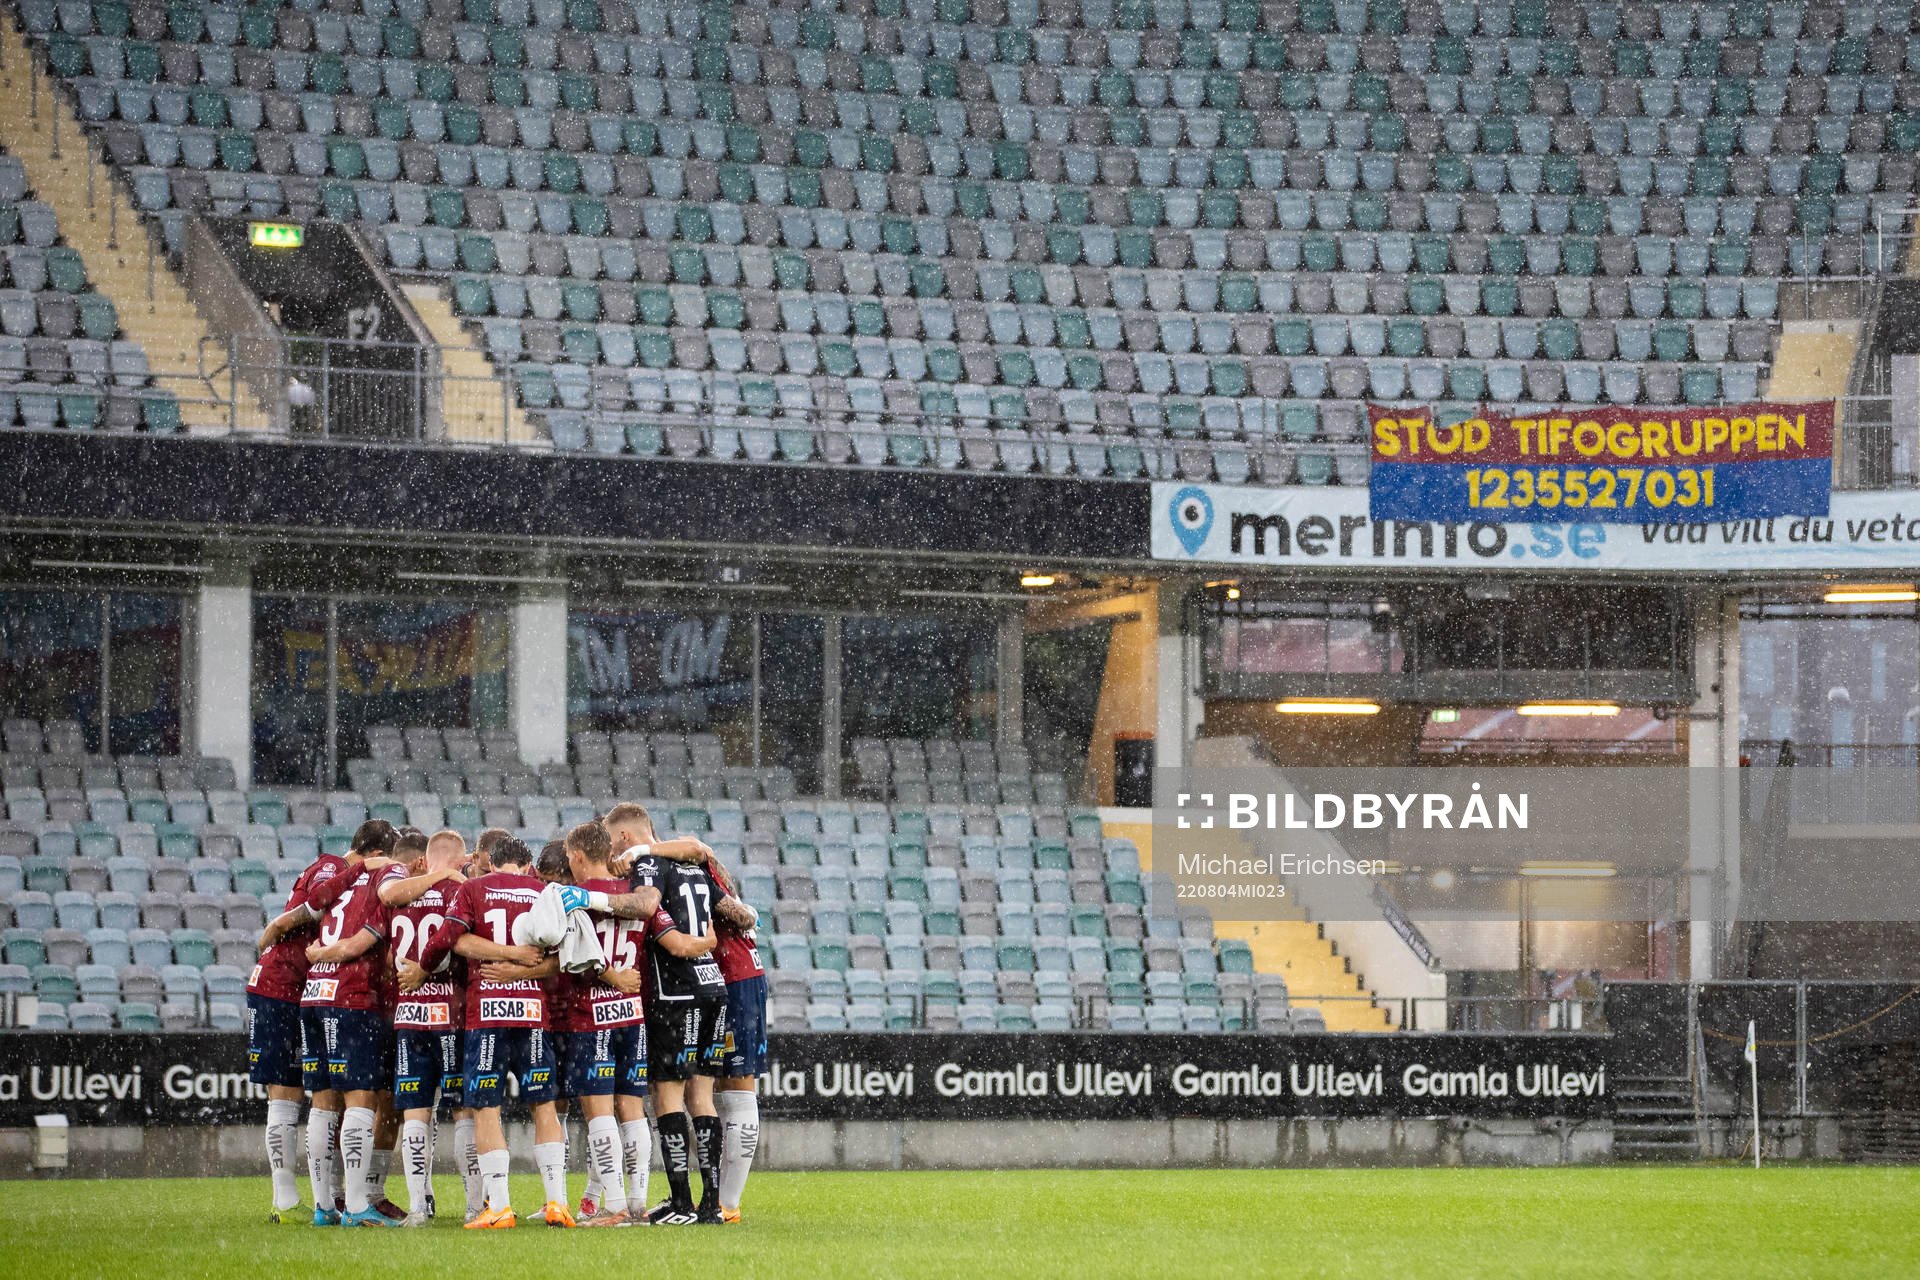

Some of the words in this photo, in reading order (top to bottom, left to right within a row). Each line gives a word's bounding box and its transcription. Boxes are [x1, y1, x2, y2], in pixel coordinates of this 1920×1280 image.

[1513, 413, 1806, 458] TIFOGRUPPEN
[1466, 467, 1715, 509] 1235527031
[1721, 517, 1774, 544] vill
[1789, 517, 1833, 543] du
[321, 890, 354, 946] 3
[596, 918, 644, 973] 15
[303, 982, 321, 999] SAB
[395, 1004, 429, 1022] BESAB
[482, 1001, 525, 1019] BESAB
[595, 1001, 634, 1022] BESAB
[704, 1043, 725, 1059] NTE
[30, 1065, 142, 1101] Ullevi
[163, 1064, 268, 1100] Gam
[627, 1063, 647, 1080] NTE
[814, 1062, 914, 1097] Ullevi
[934, 1062, 1048, 1097] Gamla
[1057, 1062, 1153, 1097] Ullevi
[1171, 1063, 1282, 1097] Gamla
[1290, 1063, 1383, 1097] Ullevi
[1402, 1063, 1507, 1097] Gamla
[1516, 1063, 1605, 1097] Ullevi
[268, 1123, 283, 1169] MIKE
[344, 1128, 363, 1169] MIKE
[409, 1135, 425, 1175] MIKE
[593, 1136, 615, 1175] MIKE
[624, 1140, 637, 1176] MIKE
[665, 1133, 687, 1172] MIKE
[697, 1128, 711, 1169] MIKE
[741, 1123, 759, 1159] MIKE
